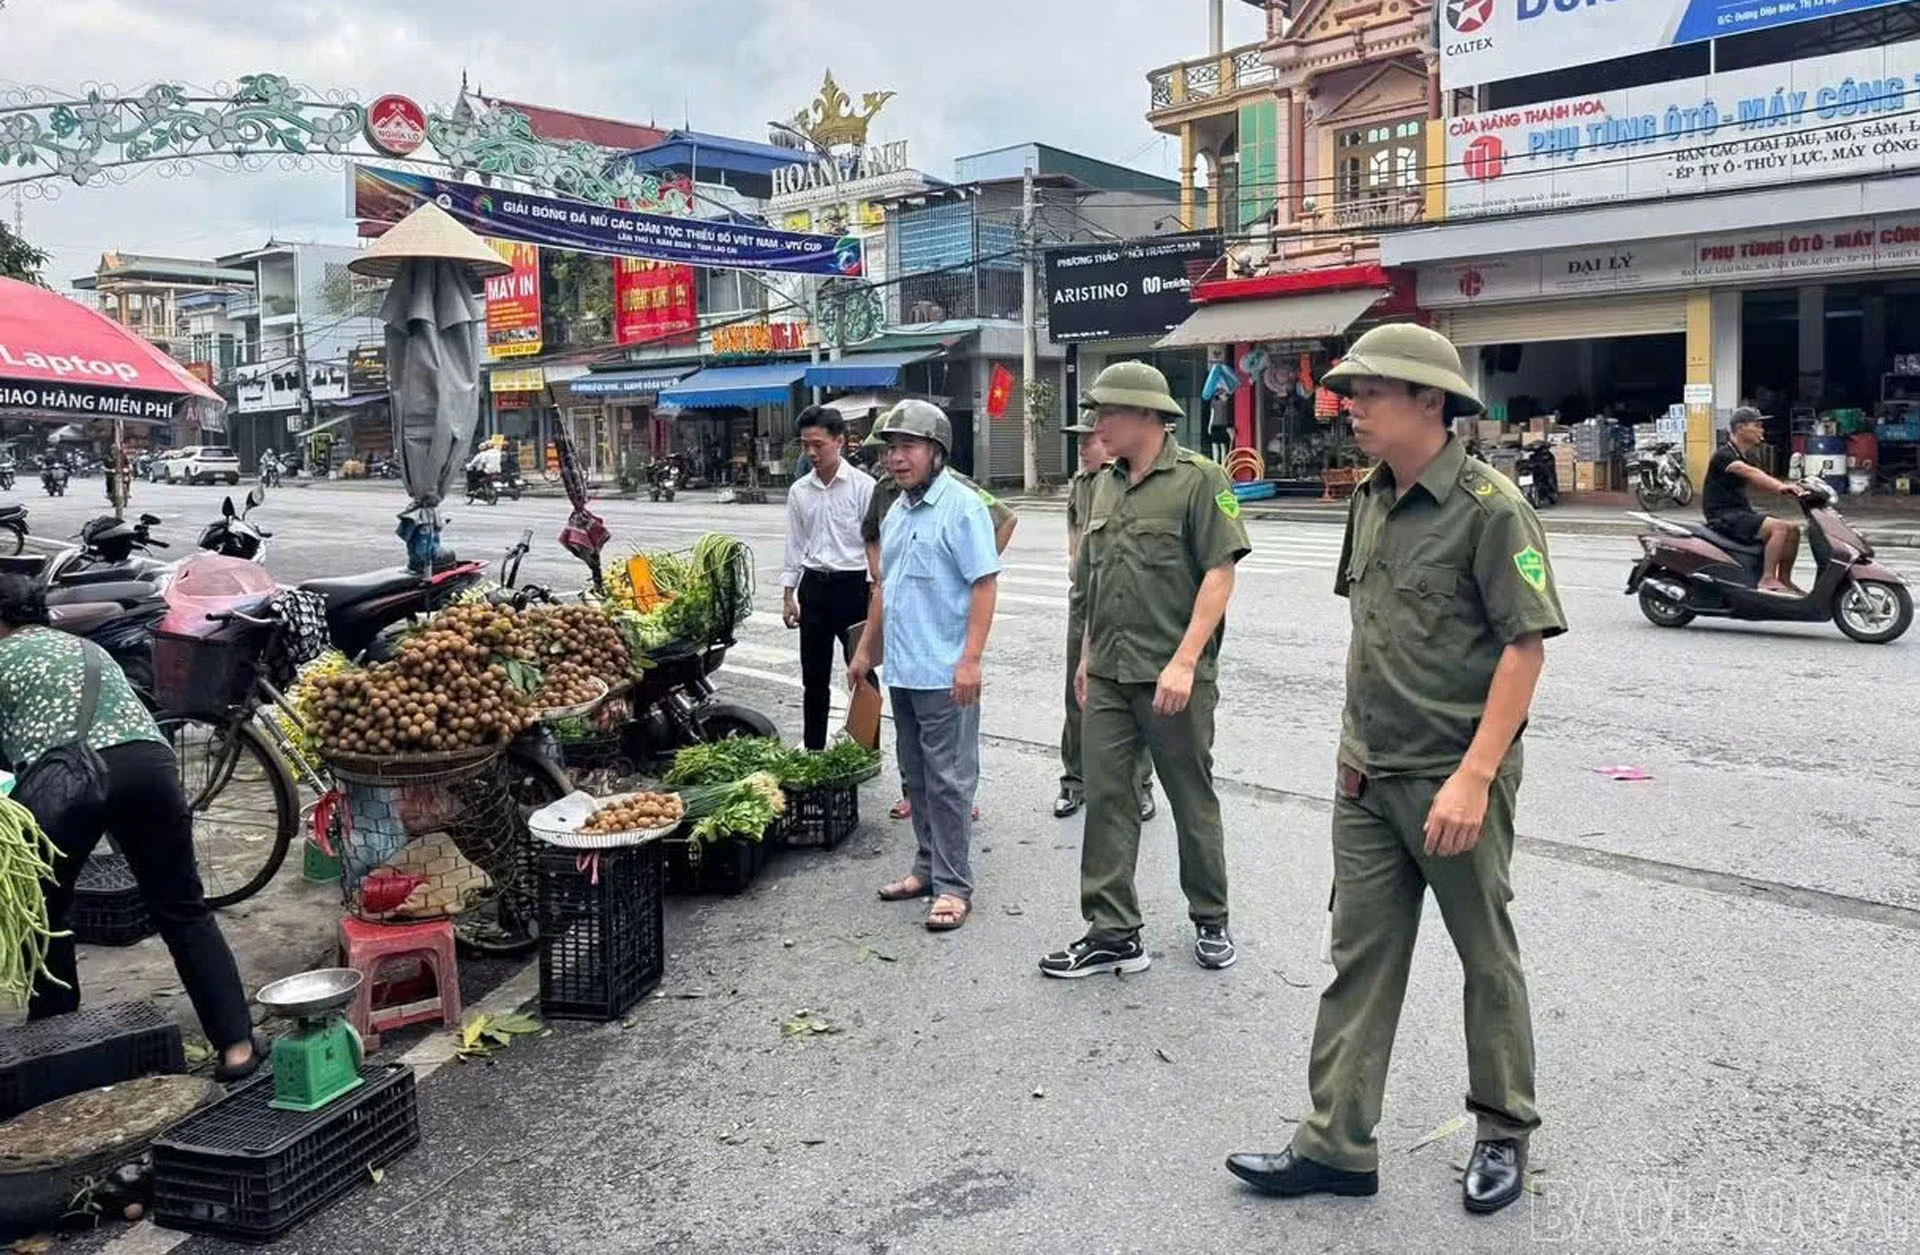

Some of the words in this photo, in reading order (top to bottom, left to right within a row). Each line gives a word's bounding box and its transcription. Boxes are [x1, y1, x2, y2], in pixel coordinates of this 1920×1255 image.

[1446, 37, 1493, 56] CALTEX
[1450, 117, 1478, 137] CỬA
[1528, 122, 1581, 162] PHỤ
[1587, 114, 1657, 152] TÙNG
[1663, 101, 1718, 141] ÔTÔ
[1738, 87, 1807, 131] MÁY
[1817, 77, 1905, 120] CÔNG
[1676, 163, 1694, 180] ÉP
[1700, 162, 1720, 176] TY
[1832, 143, 1867, 161] MÁY
[532, 206, 567, 222] BÓNG
[570, 211, 588, 225] ĐÁ
[611, 216, 633, 231] CÁC
[664, 224, 684, 239] TỘC
[733, 233, 755, 247] VIỆT
[756, 236, 779, 249] NAM
[803, 242, 823, 252] CUP
[1701, 246, 1735, 262] PHỤ
[1740, 239, 1784, 257] TÙNG
[1834, 229, 1874, 249] MÁY
[1568, 260, 1601, 275] ĐẠI
[520, 274, 534, 296] IN
[1054, 282, 1129, 304] ARISTINO
[0, 344, 139, 382] Laptop
[42, 391, 95, 410] HÀNG
[145, 402, 174, 418] PHÍ
